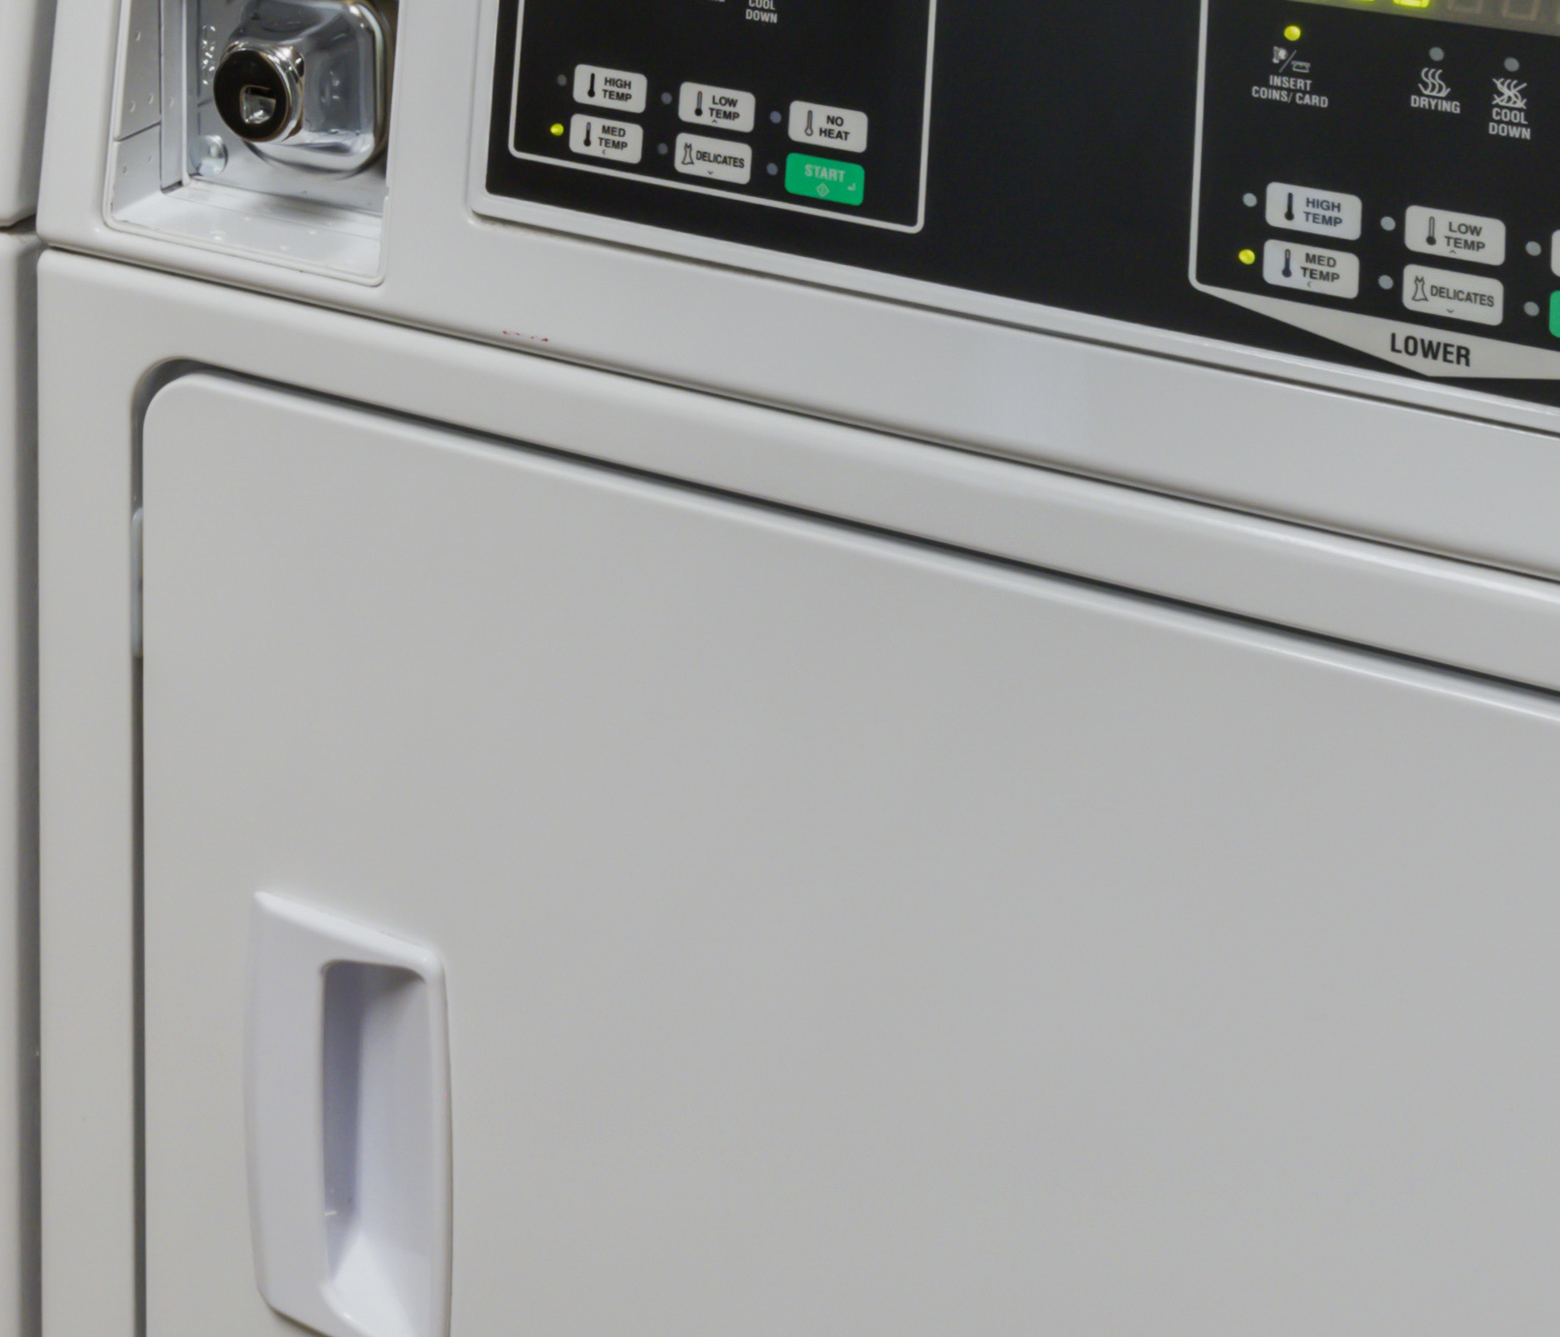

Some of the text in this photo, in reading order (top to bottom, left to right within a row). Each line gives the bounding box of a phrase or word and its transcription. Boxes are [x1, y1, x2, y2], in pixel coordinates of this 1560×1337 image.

[745, 9, 778, 24] DOWN
[1409, 94, 1461, 114] DRYING
[695, 150, 746, 169] DELICATES
[804, 164, 846, 183] START
[1429, 284, 1495, 309] DELICATES
[1389, 332, 1473, 368] LOWER
